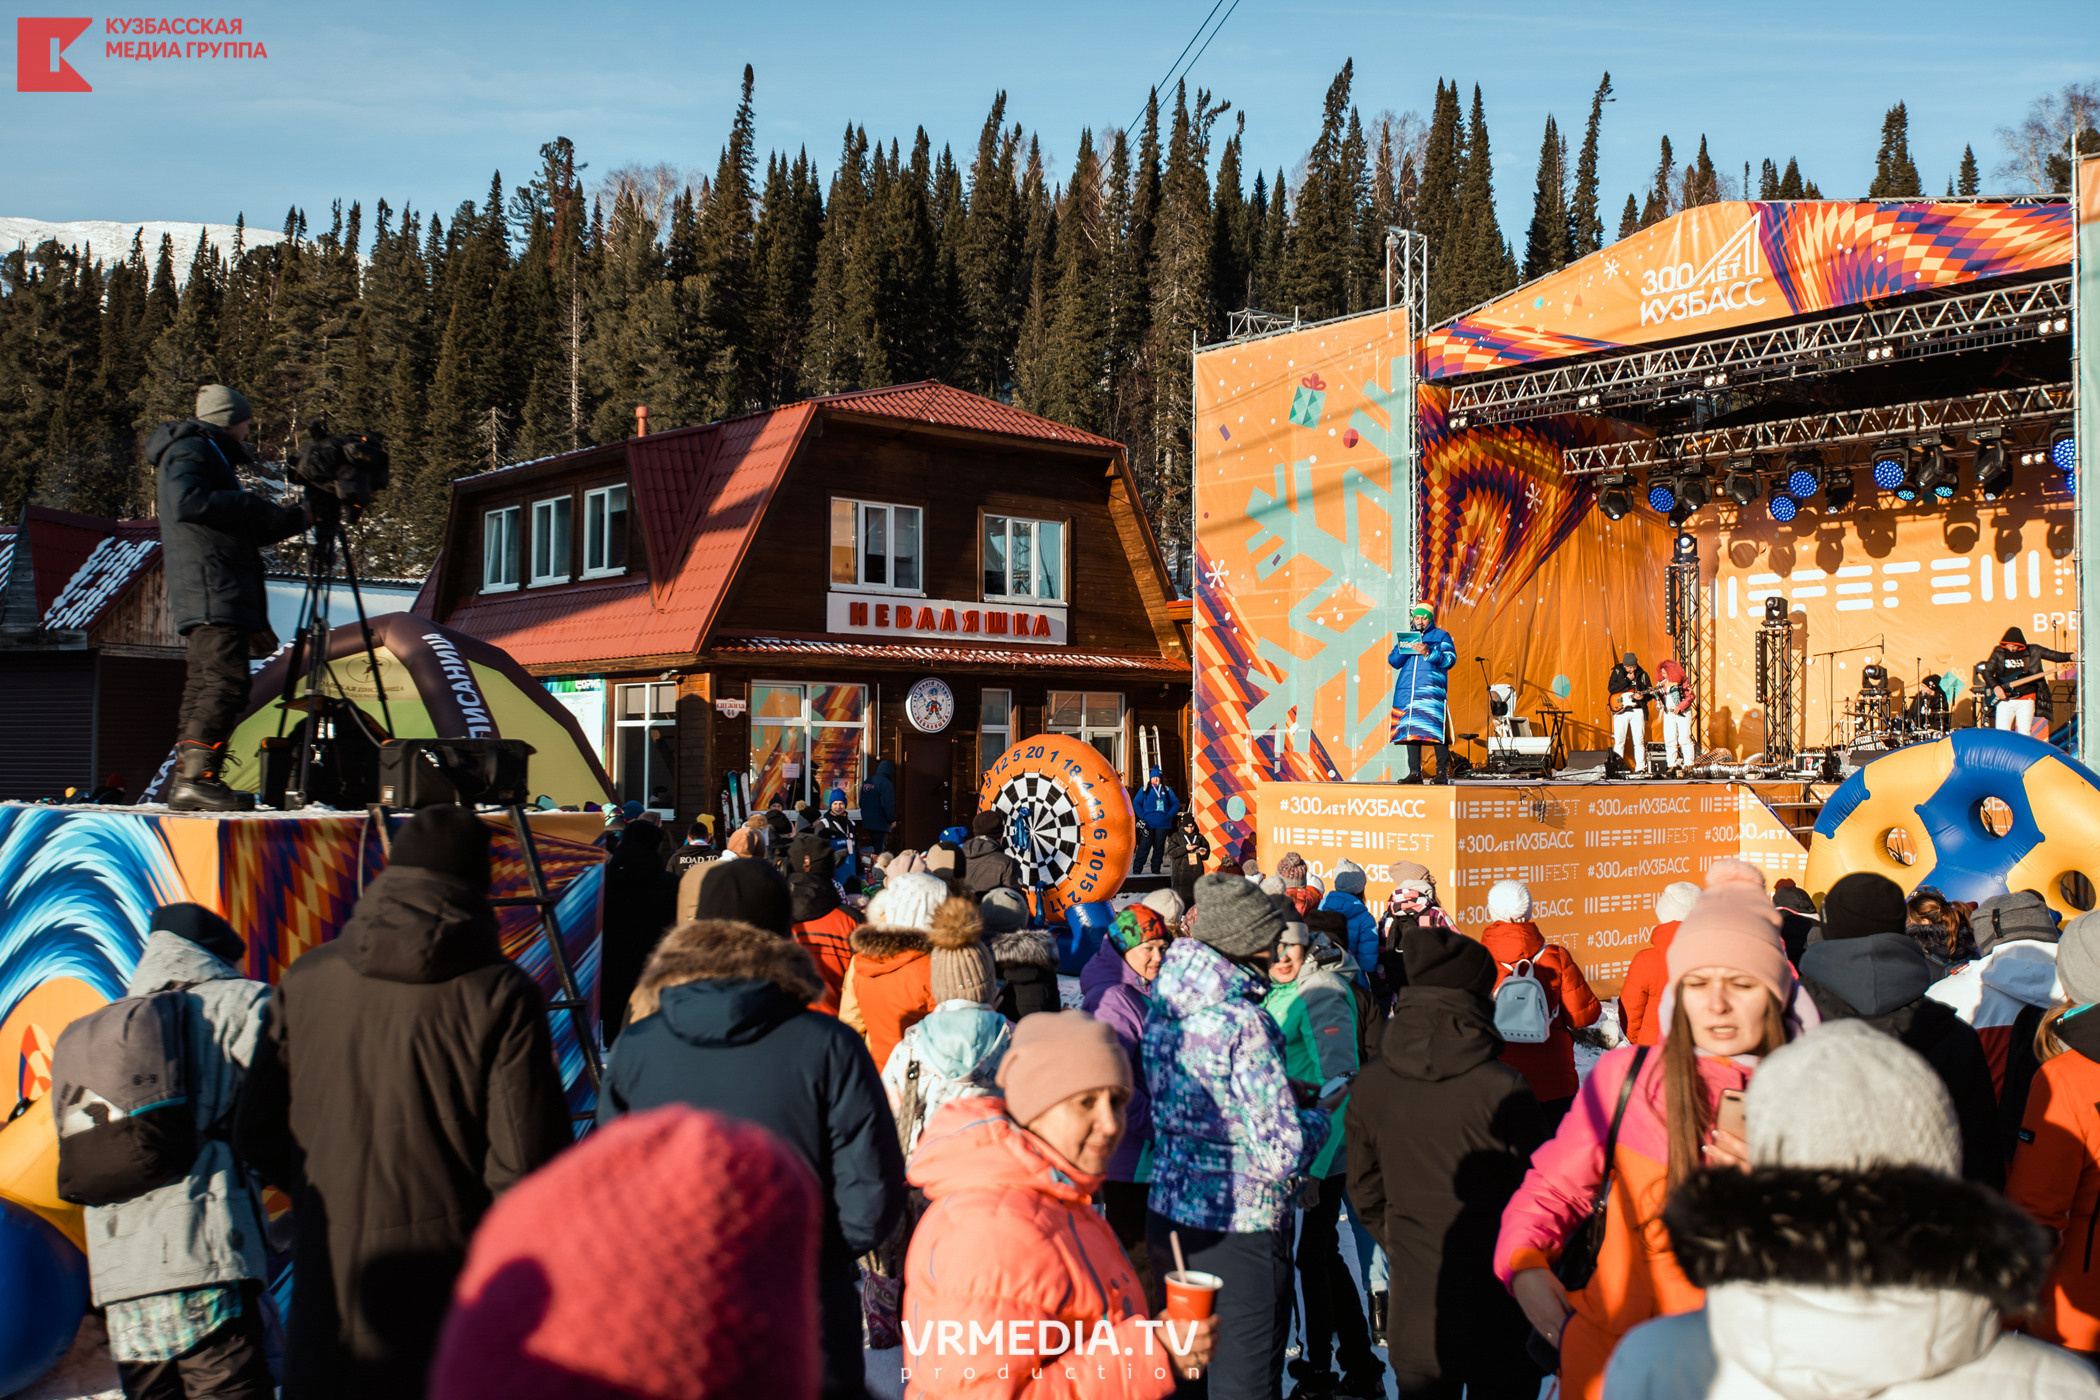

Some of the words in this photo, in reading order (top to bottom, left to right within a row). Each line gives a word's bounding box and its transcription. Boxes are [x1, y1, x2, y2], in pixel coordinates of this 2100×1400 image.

[1641, 262, 1694, 296] 300
[1640, 278, 1767, 327] КУЗБАСС
[849, 601, 1051, 637] НЕВАЛЯШКА
[2033, 611, 2077, 632] ВРЕ
[1012, 749, 1021, 762] 5
[1025, 746, 1045, 759] 20
[1050, 750, 1060, 763] 1
[994, 757, 1008, 775] 12
[1063, 758, 1082, 778] 18
[1082, 782, 1095, 793] 4
[1087, 798, 1105, 821] 13
[1093, 828, 1108, 841] 6
[679, 856, 705, 864] ROAD
[1089, 849, 1106, 870] 10
[1079, 872, 1098, 893] 15
[1050, 898, 1067, 913] 17
[1067, 890, 1082, 904] 2
